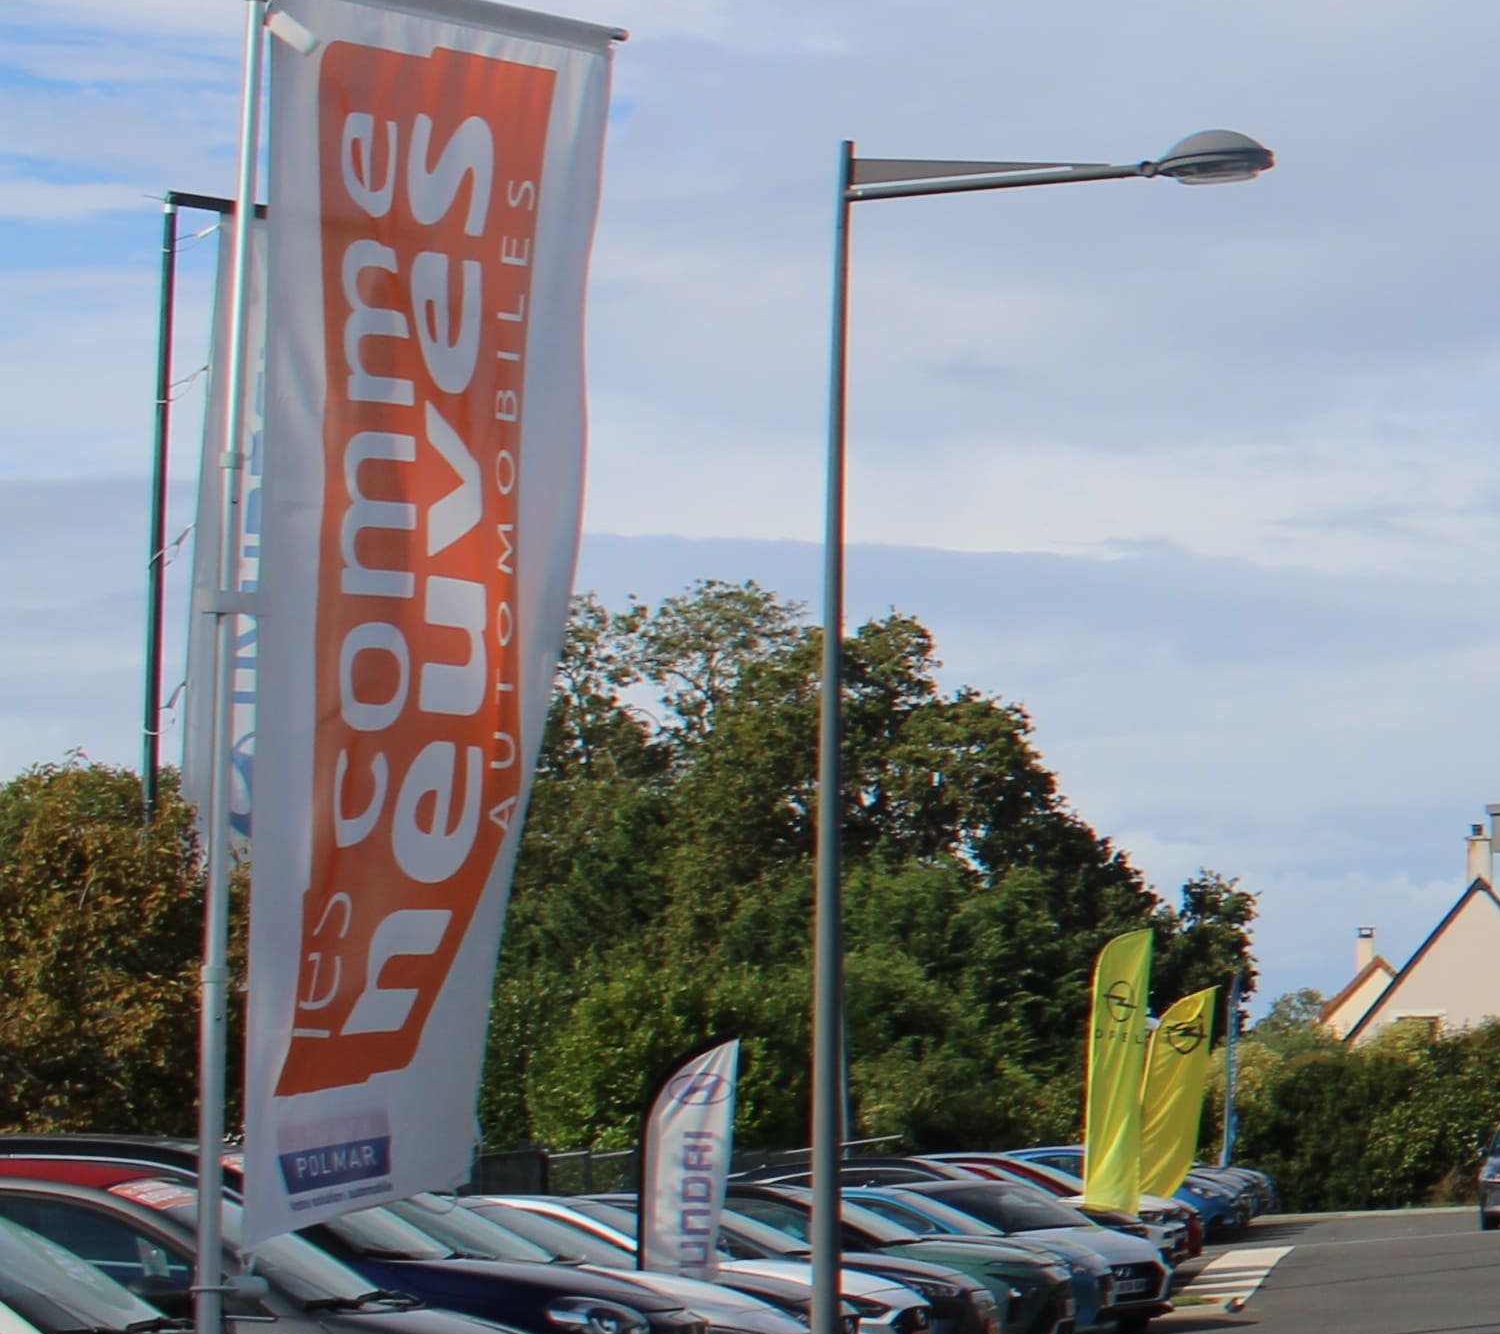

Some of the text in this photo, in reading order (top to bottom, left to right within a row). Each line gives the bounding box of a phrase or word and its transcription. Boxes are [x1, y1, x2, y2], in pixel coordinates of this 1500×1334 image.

[293, 112, 416, 1038] les comme
[340, 113, 496, 1035] neuves
[489, 178, 537, 831] AUTOMOBILES
[295, 1145, 377, 1178] POLMAR
[678, 1131, 713, 1276] UNDAI
[1095, 1028, 1145, 1044] OPEL
